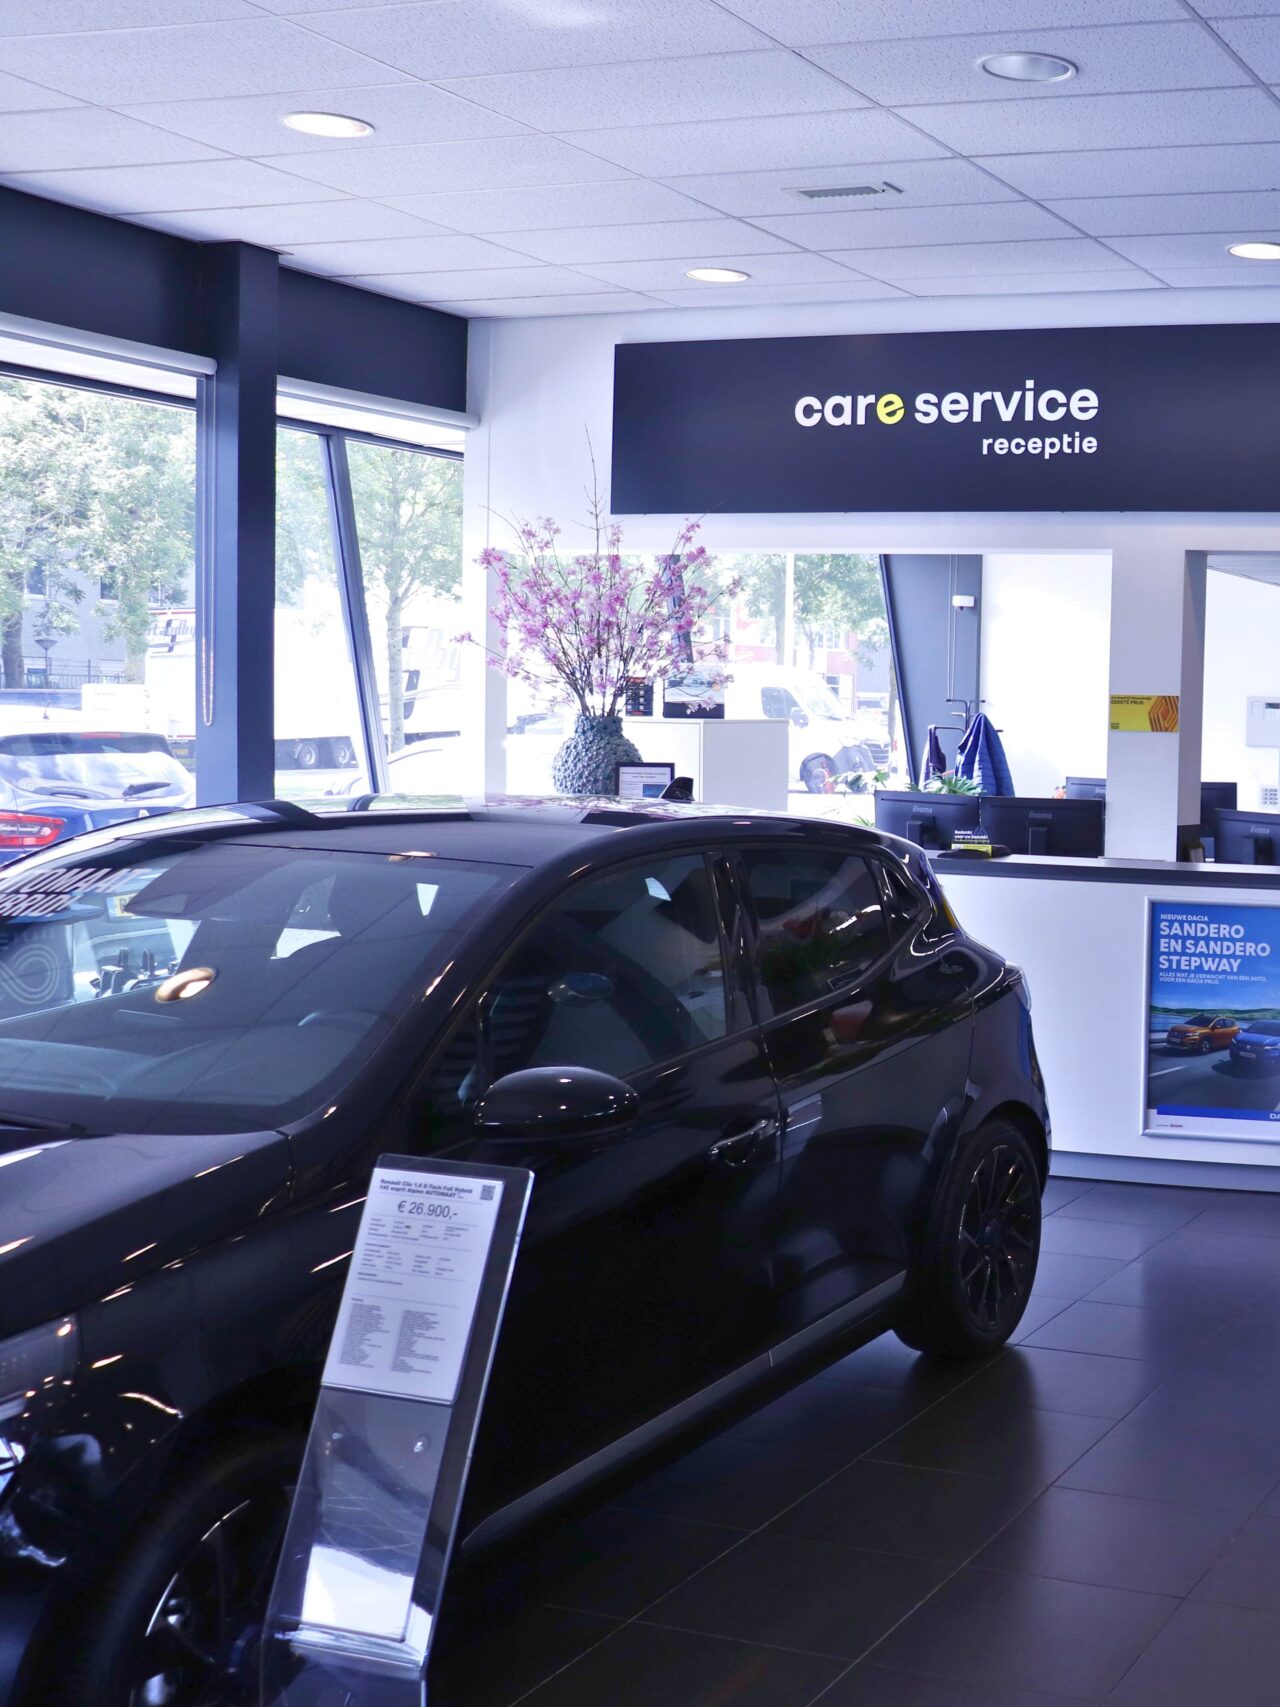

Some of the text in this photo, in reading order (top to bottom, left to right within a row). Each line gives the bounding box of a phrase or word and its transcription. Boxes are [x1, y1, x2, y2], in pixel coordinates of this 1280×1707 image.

[795, 379, 1099, 427] care service
[982, 431, 1098, 459] receptie
[1160, 922, 1244, 938] SANDERO
[1160, 939, 1270, 956] EN SANDERO
[1159, 955, 1242, 972] STEPWAY
[398, 1200, 458, 1220] € 26.900,-
